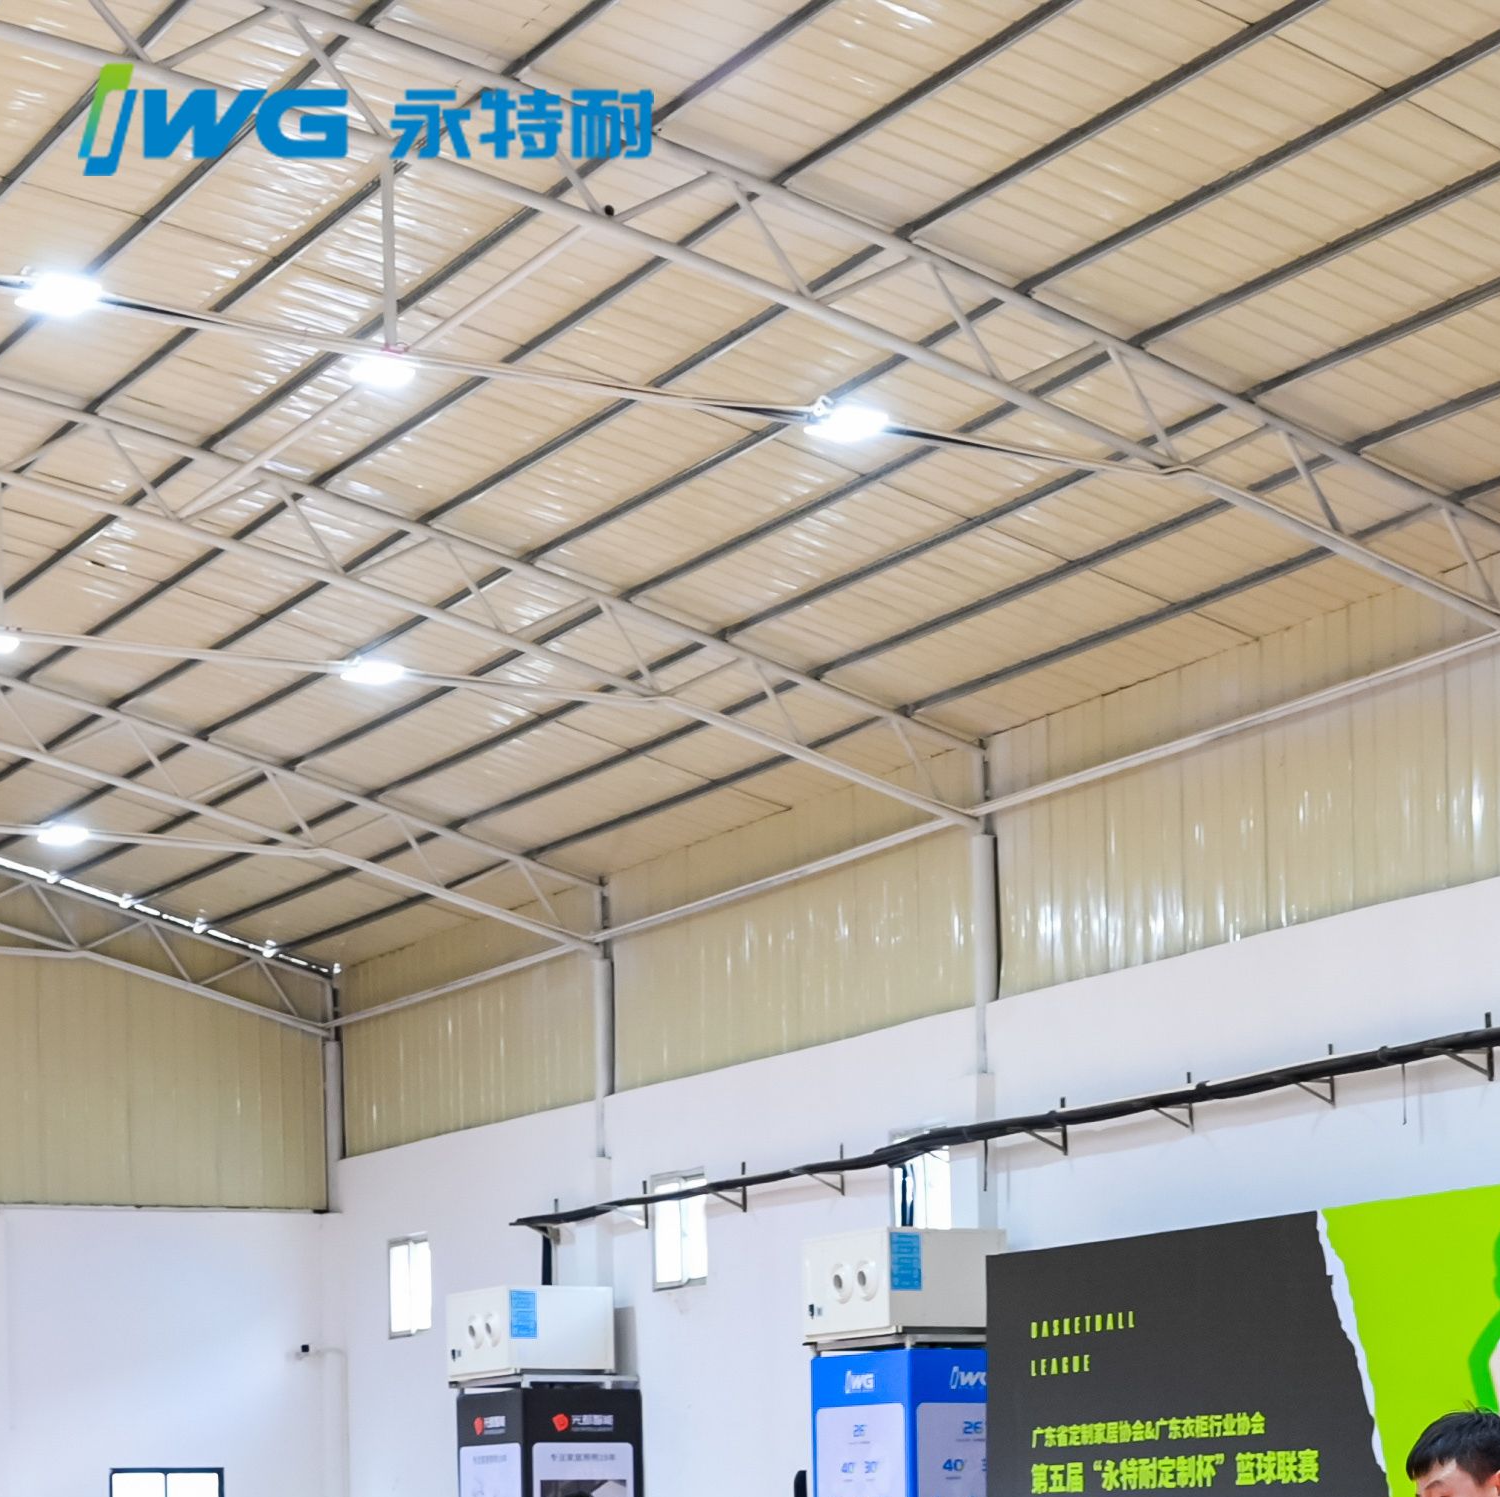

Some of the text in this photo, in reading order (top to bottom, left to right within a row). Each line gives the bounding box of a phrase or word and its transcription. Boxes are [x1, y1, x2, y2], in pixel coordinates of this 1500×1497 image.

[1030, 1310, 1135, 1340] BASKETBALL
[1030, 1462, 1085, 1495] 第五届
[1235, 1448, 1320, 1487] 篮球联赛
